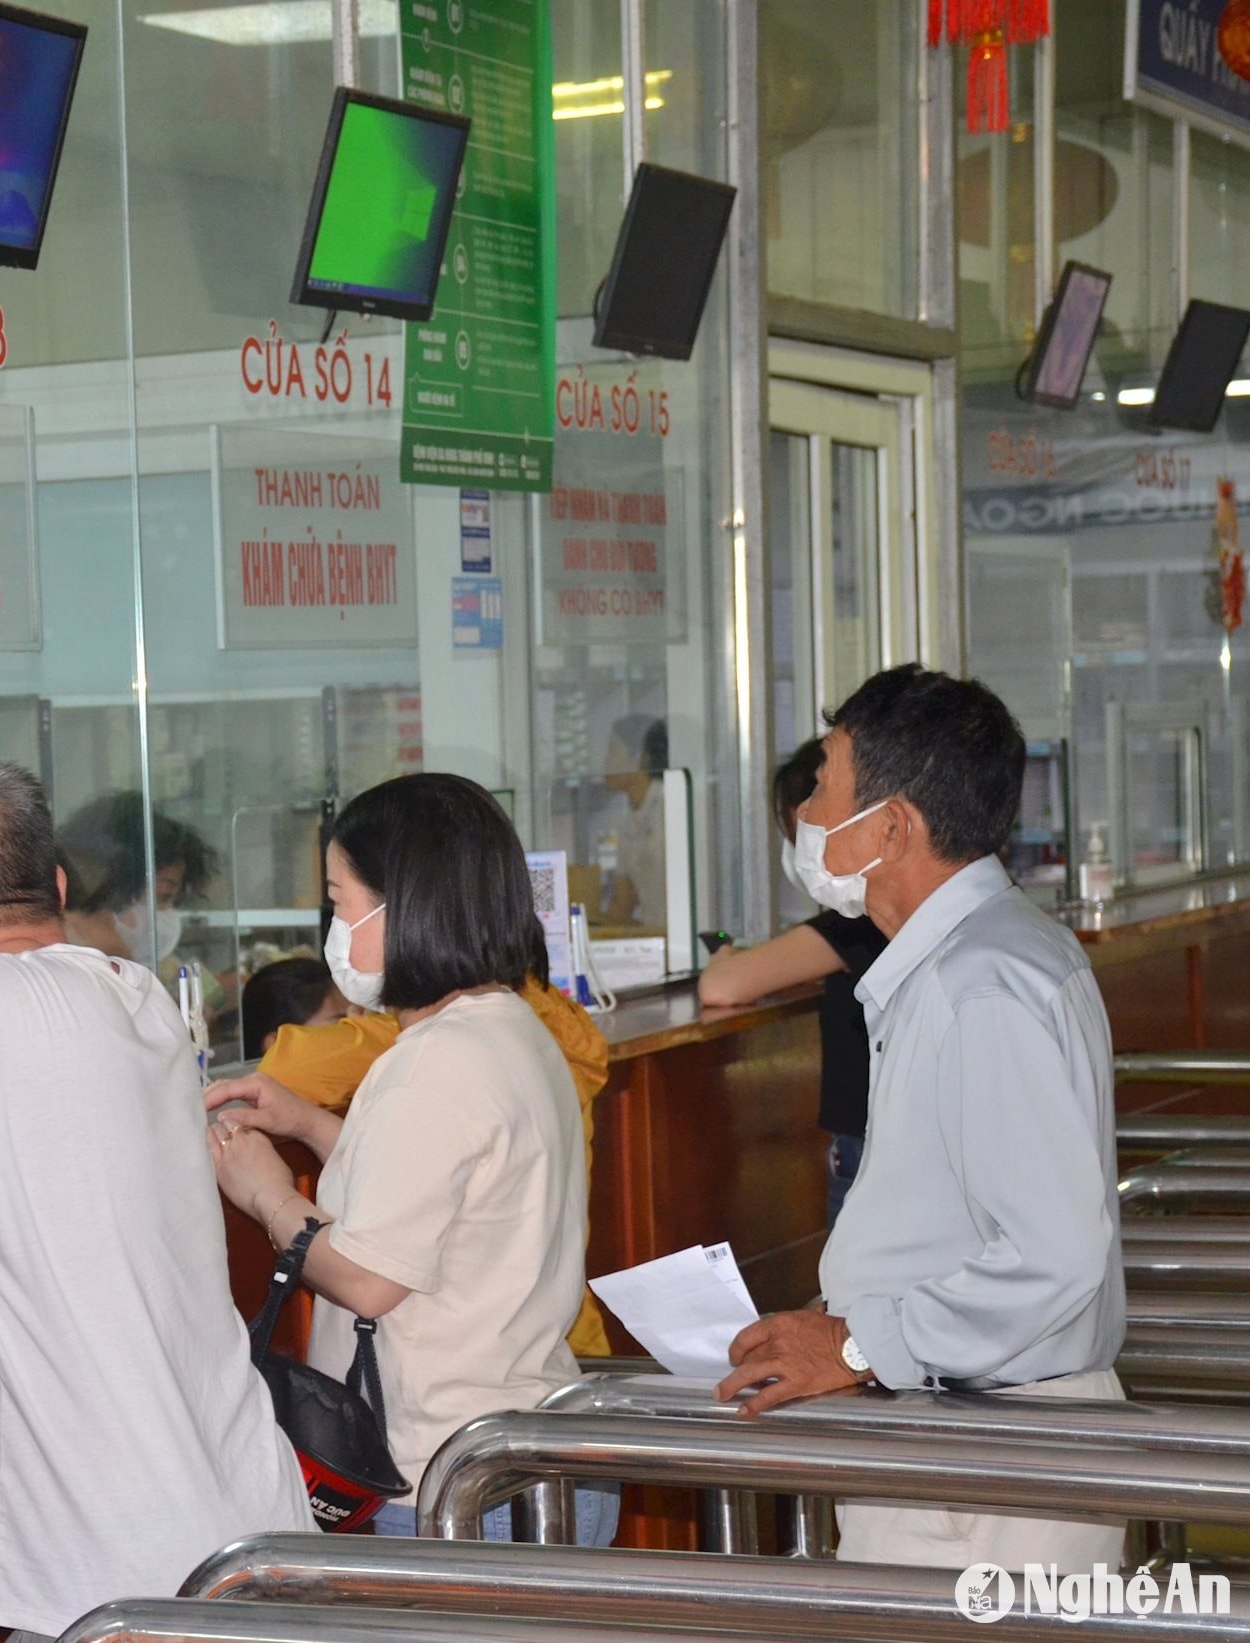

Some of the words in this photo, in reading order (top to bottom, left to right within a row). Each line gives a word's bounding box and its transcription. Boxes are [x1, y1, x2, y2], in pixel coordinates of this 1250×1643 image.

[241, 320, 306, 397] CỬA
[315, 328, 352, 403] SỐ
[364, 353, 392, 408] 14
[556, 363, 605, 431] CỬA
[612, 369, 639, 434] SỐ
[649, 389, 669, 437] 15
[255, 469, 322, 507] THANH
[328, 463, 380, 509] TOÁN
[241, 527, 284, 606] KHÁM
